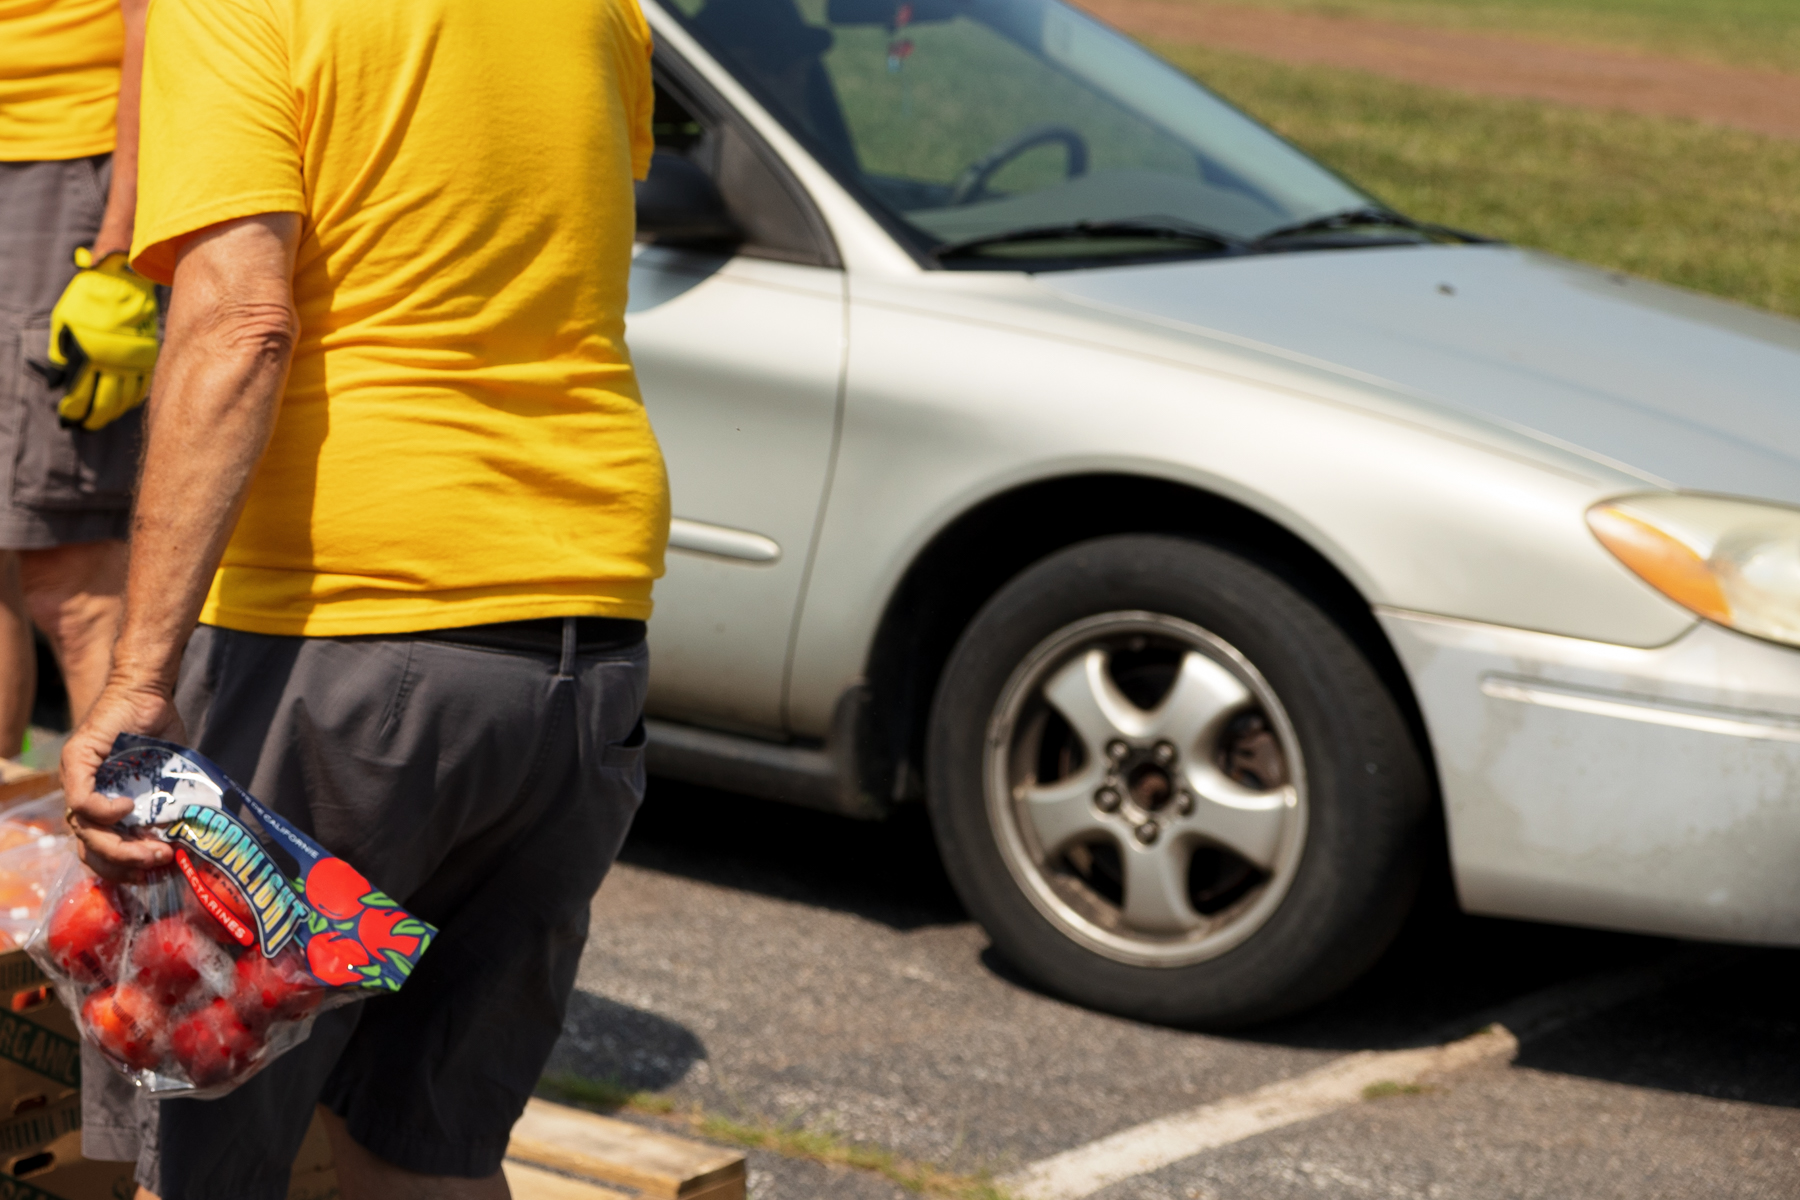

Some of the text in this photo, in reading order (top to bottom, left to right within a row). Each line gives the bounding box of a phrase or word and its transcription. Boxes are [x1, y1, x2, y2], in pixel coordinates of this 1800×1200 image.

[263, 812, 319, 859] CALIFORNIE
[168, 804, 307, 952] MOONLIGHT
[181, 857, 246, 939] NECTARINES
